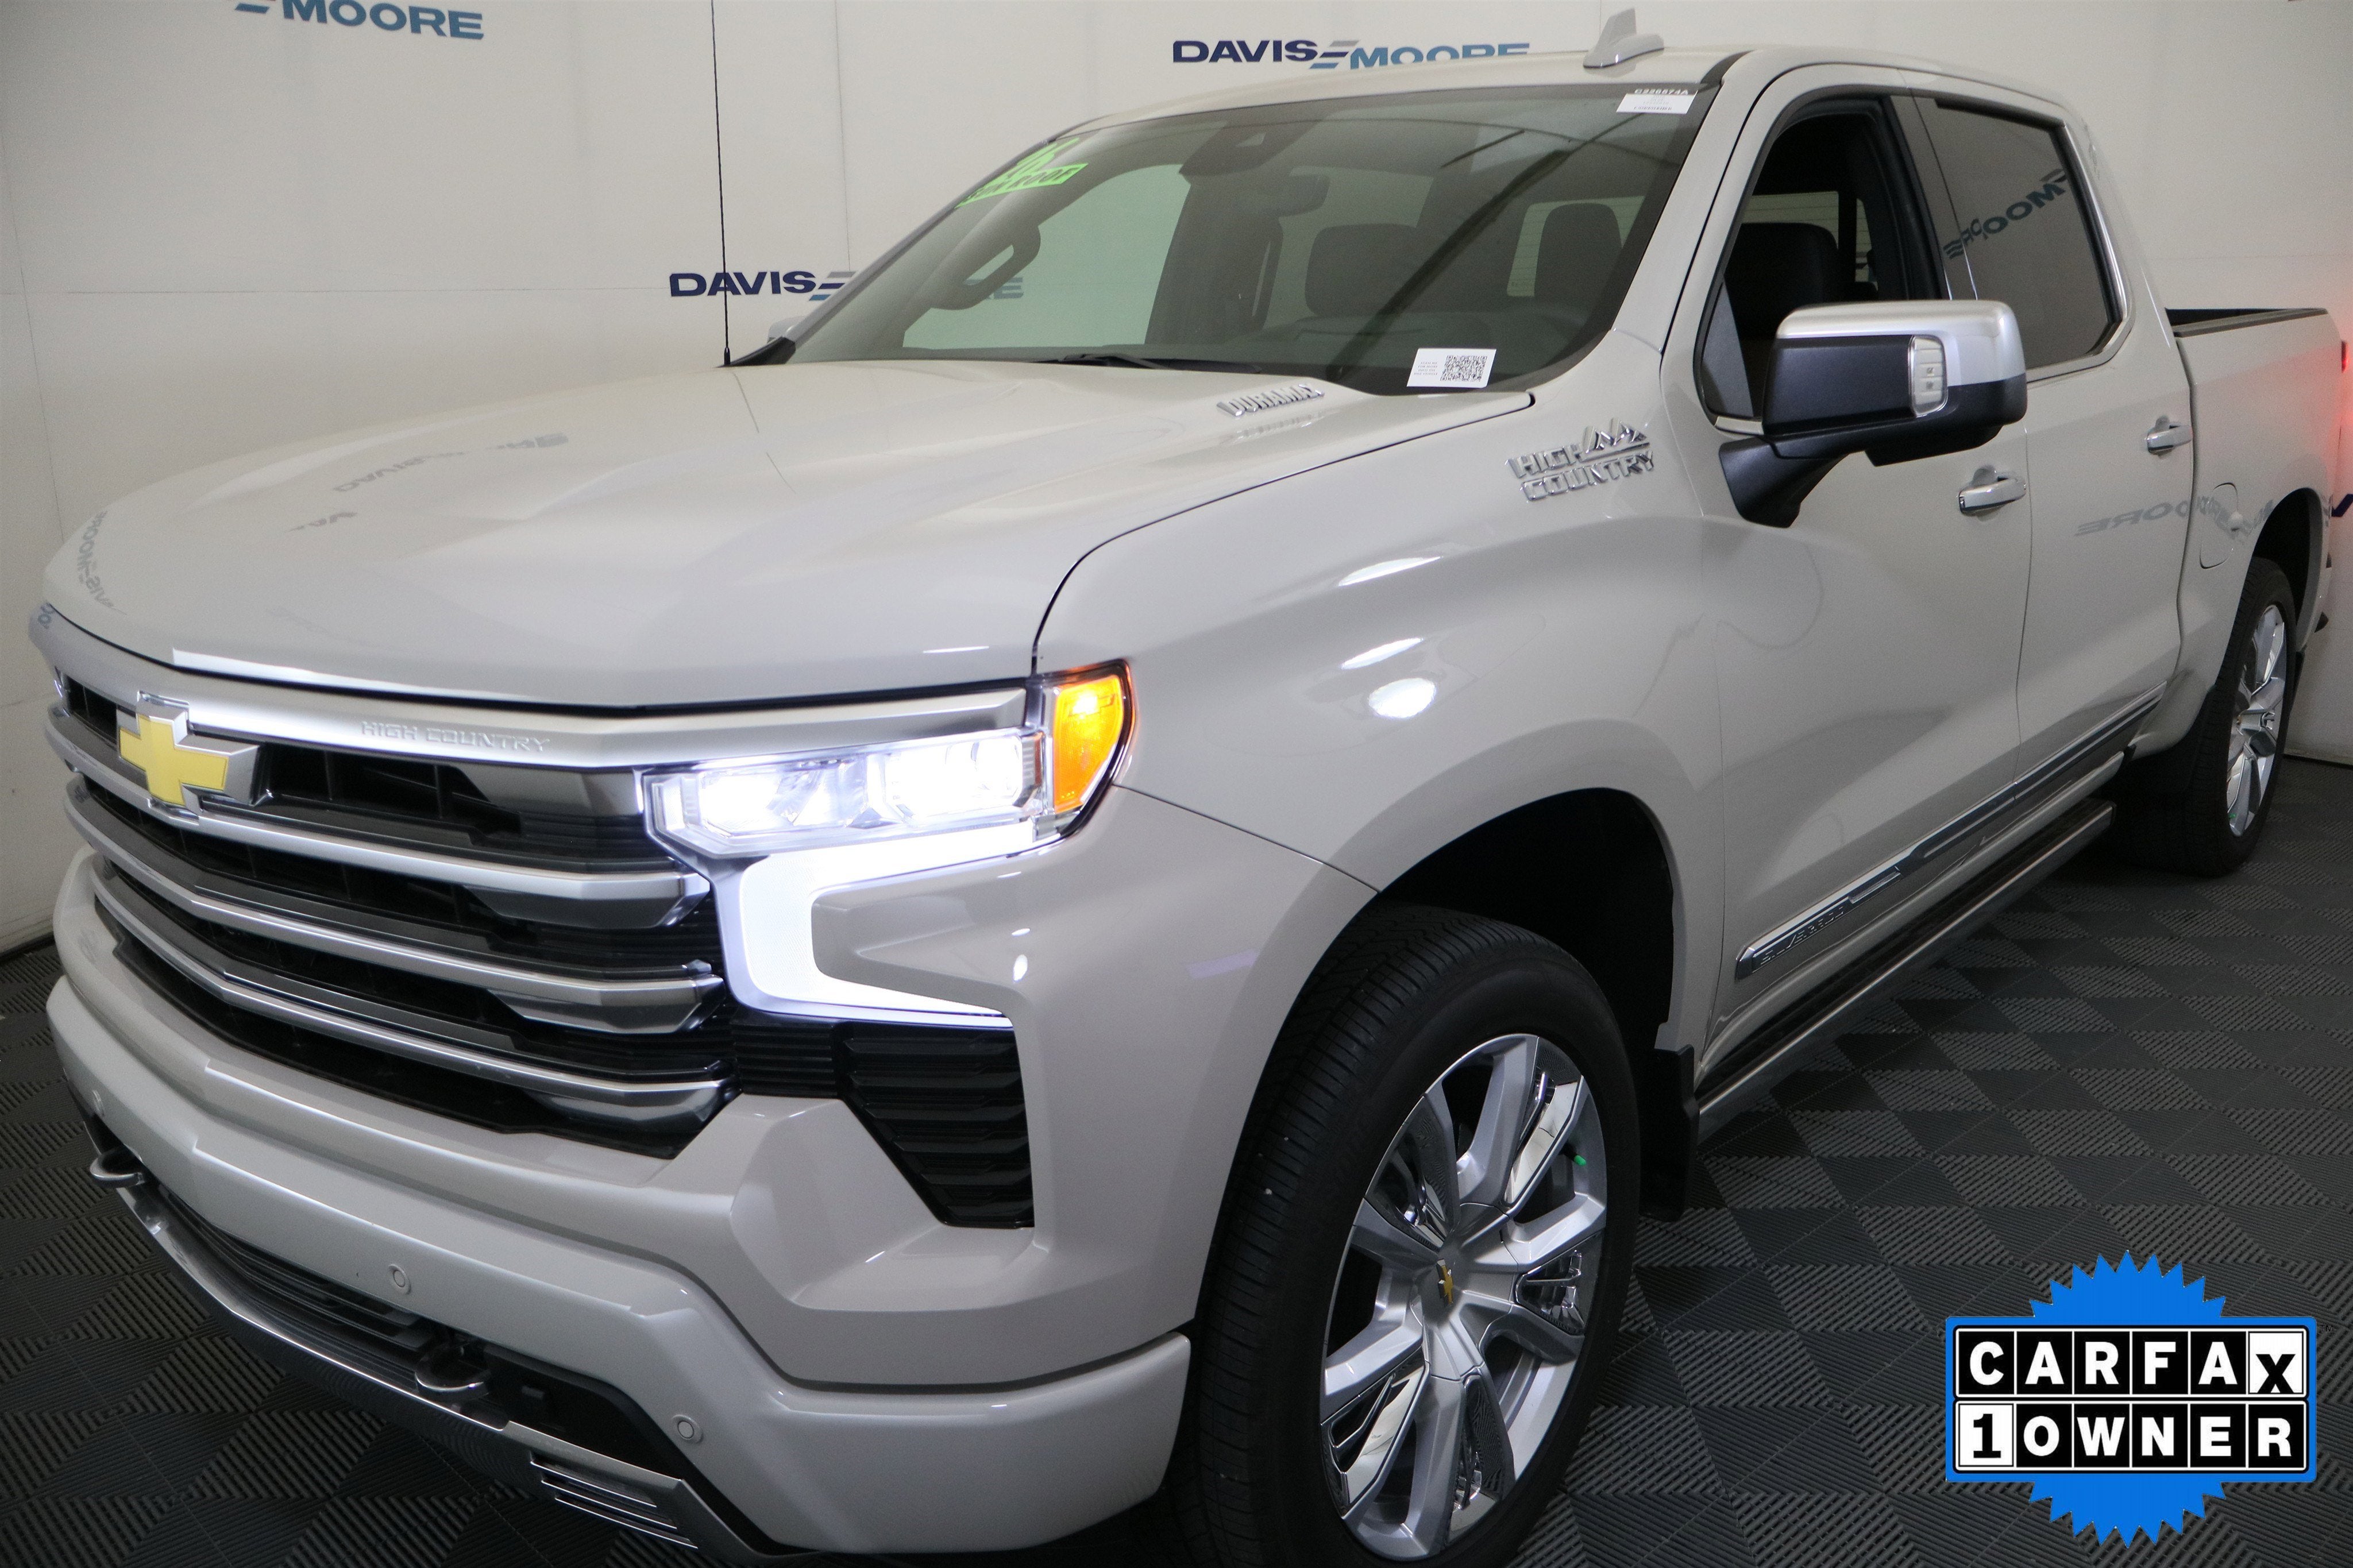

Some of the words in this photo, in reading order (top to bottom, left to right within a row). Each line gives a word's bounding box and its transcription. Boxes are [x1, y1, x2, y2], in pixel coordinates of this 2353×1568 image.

[282, 0, 484, 40] MOORE
[1172, 40, 1320, 63] DAVIS
[669, 271, 816, 297] DAVIS
[1216, 383, 1325, 418] DURAMAX
[1505, 443, 1583, 478] HIGH
[1519, 450, 1654, 501] COUNTRY
[361, 721, 418, 740] HIGH
[426, 727, 550, 752] COUNTRY
